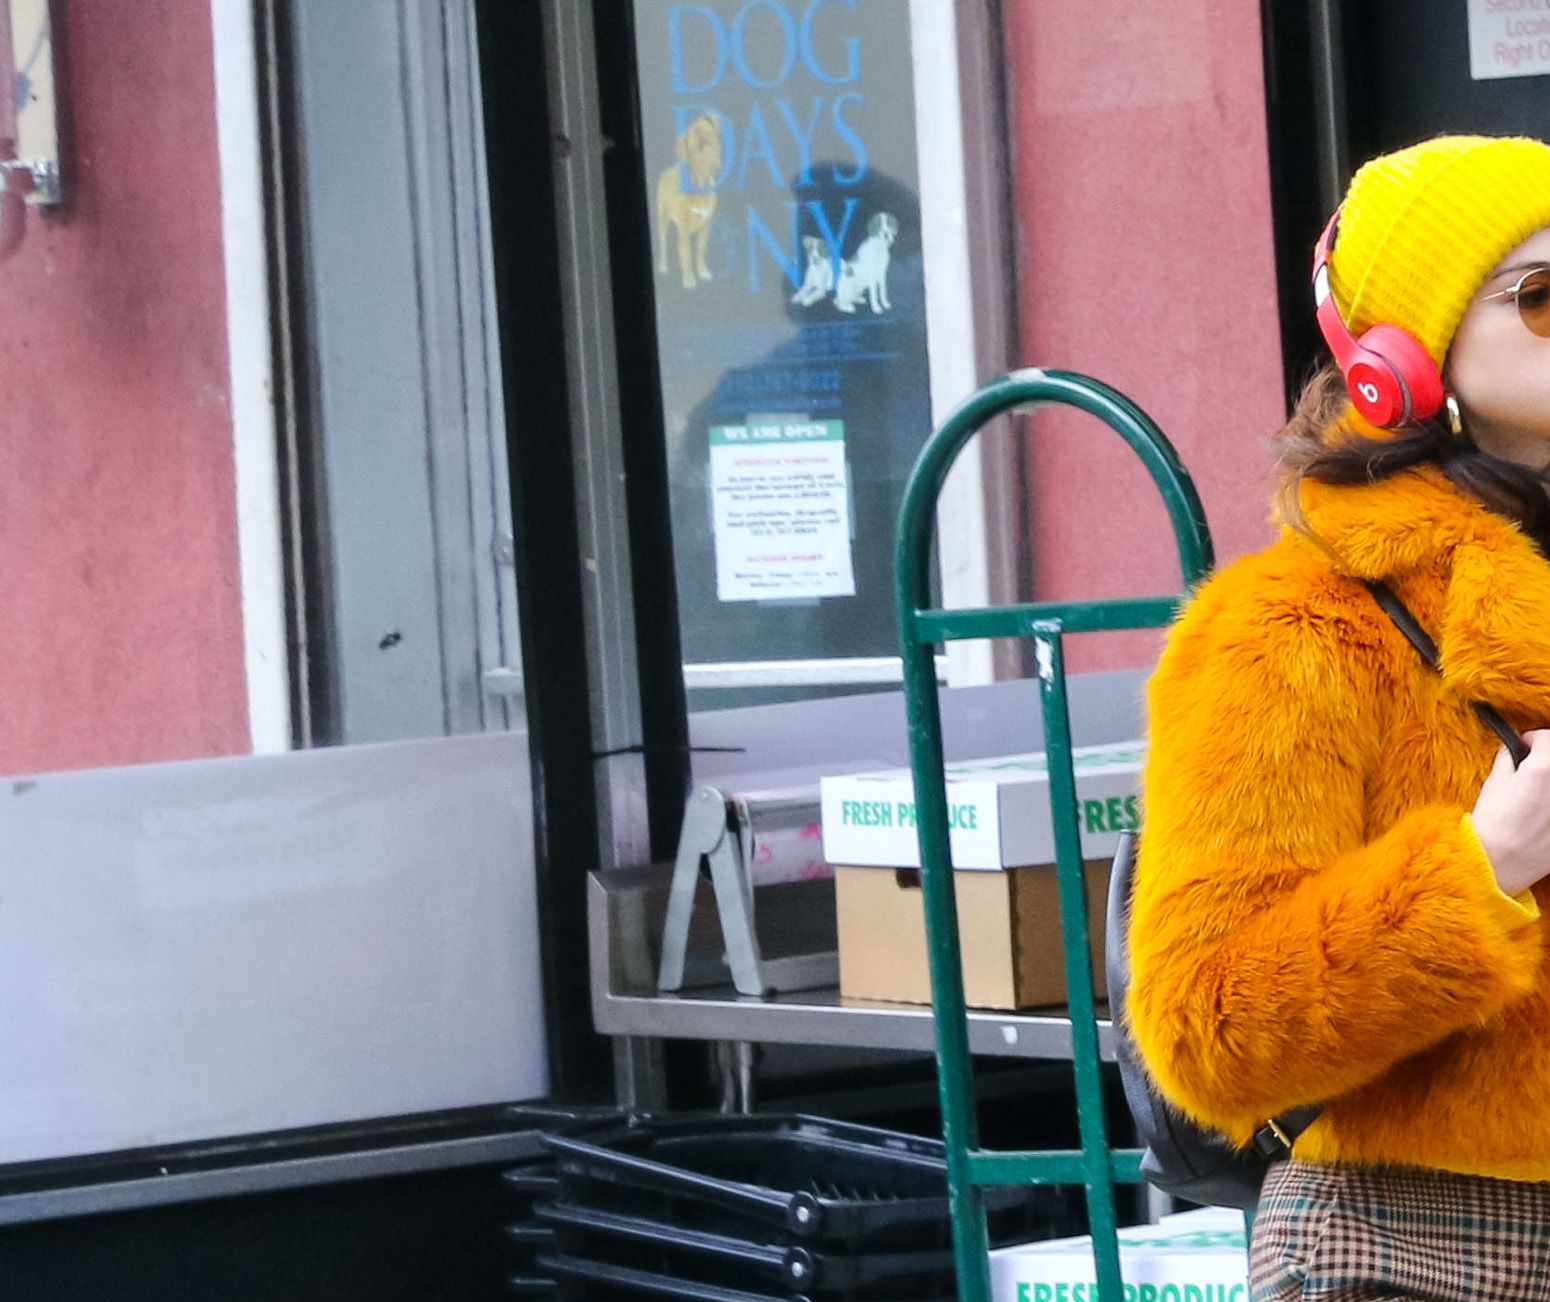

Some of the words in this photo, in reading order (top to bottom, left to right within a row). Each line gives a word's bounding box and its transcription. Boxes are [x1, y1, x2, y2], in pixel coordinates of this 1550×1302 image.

[667, 0, 861, 94] DOG
[671, 92, 869, 195] DAYS
[746, 197, 860, 294] NY
[842, 800, 893, 828] FRESH
